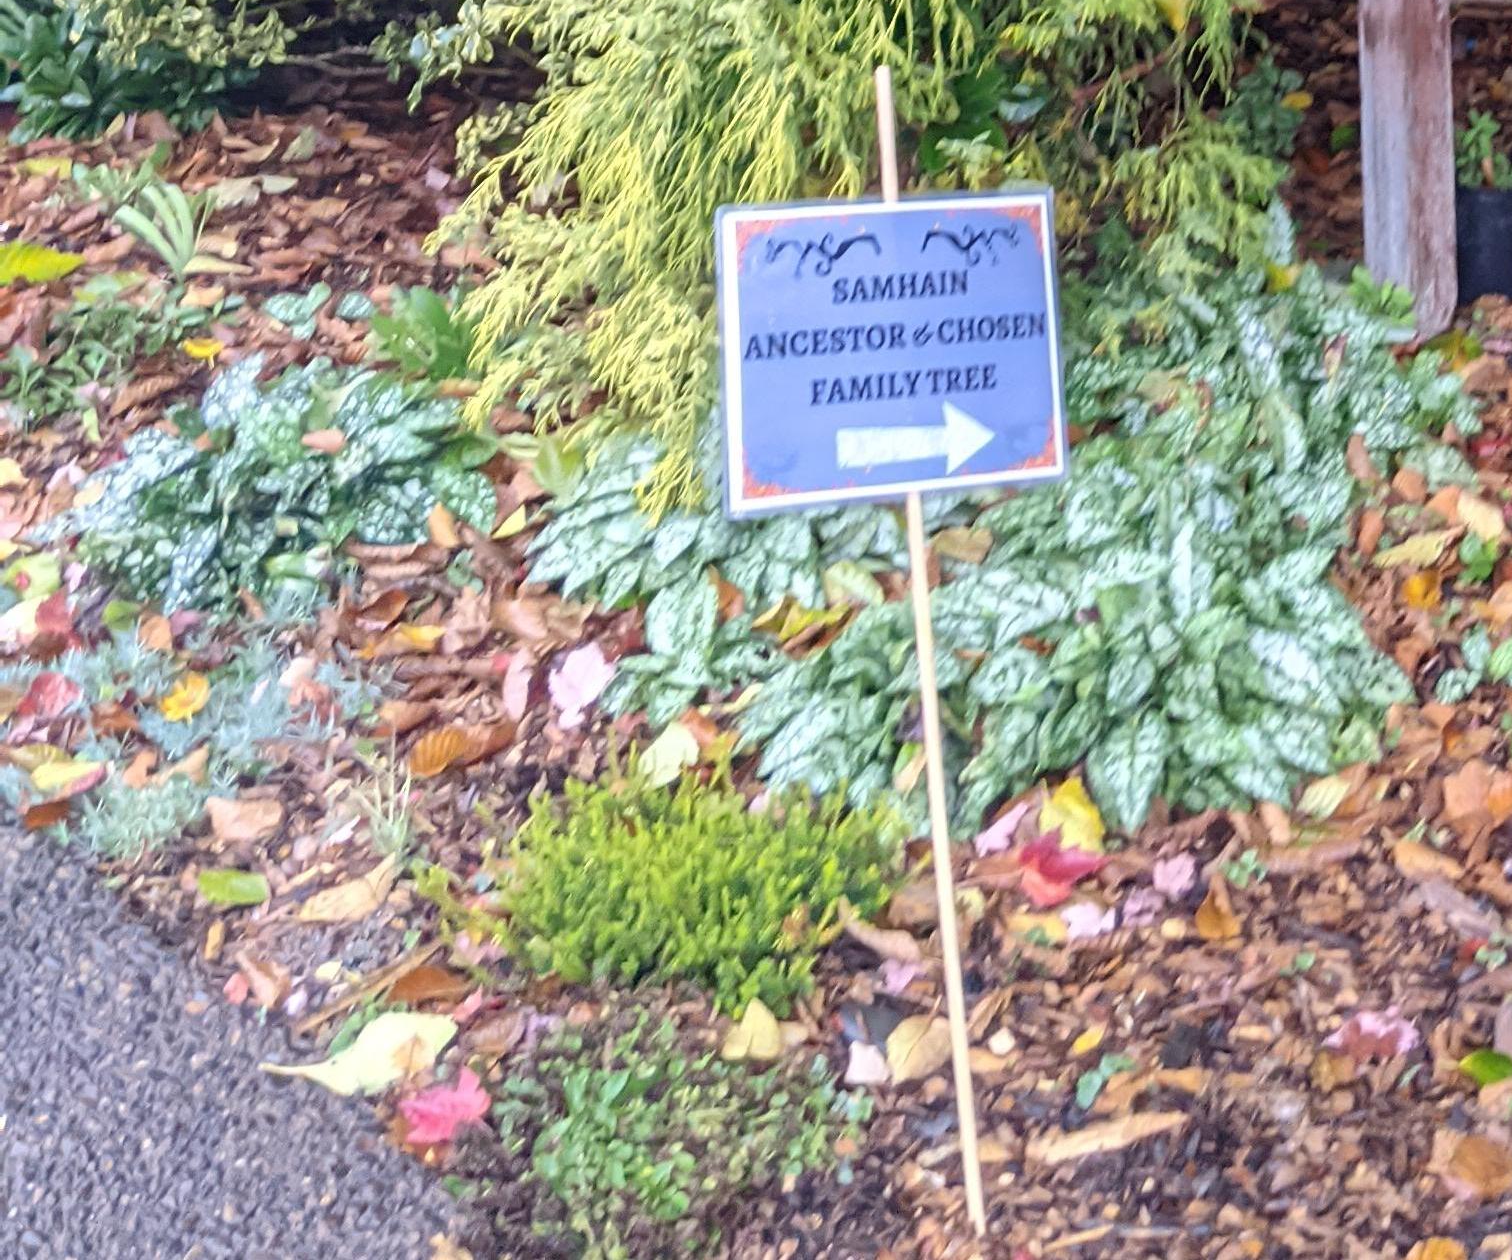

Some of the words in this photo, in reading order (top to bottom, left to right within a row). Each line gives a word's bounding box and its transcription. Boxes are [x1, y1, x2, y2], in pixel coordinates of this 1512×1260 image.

[832, 270, 969, 305] SAMHAIN
[743, 324, 907, 362] ANCESTOR
[937, 312, 1046, 343] CHOSEN
[810, 368, 925, 406] FAMILY
[926, 363, 998, 396] TREE
